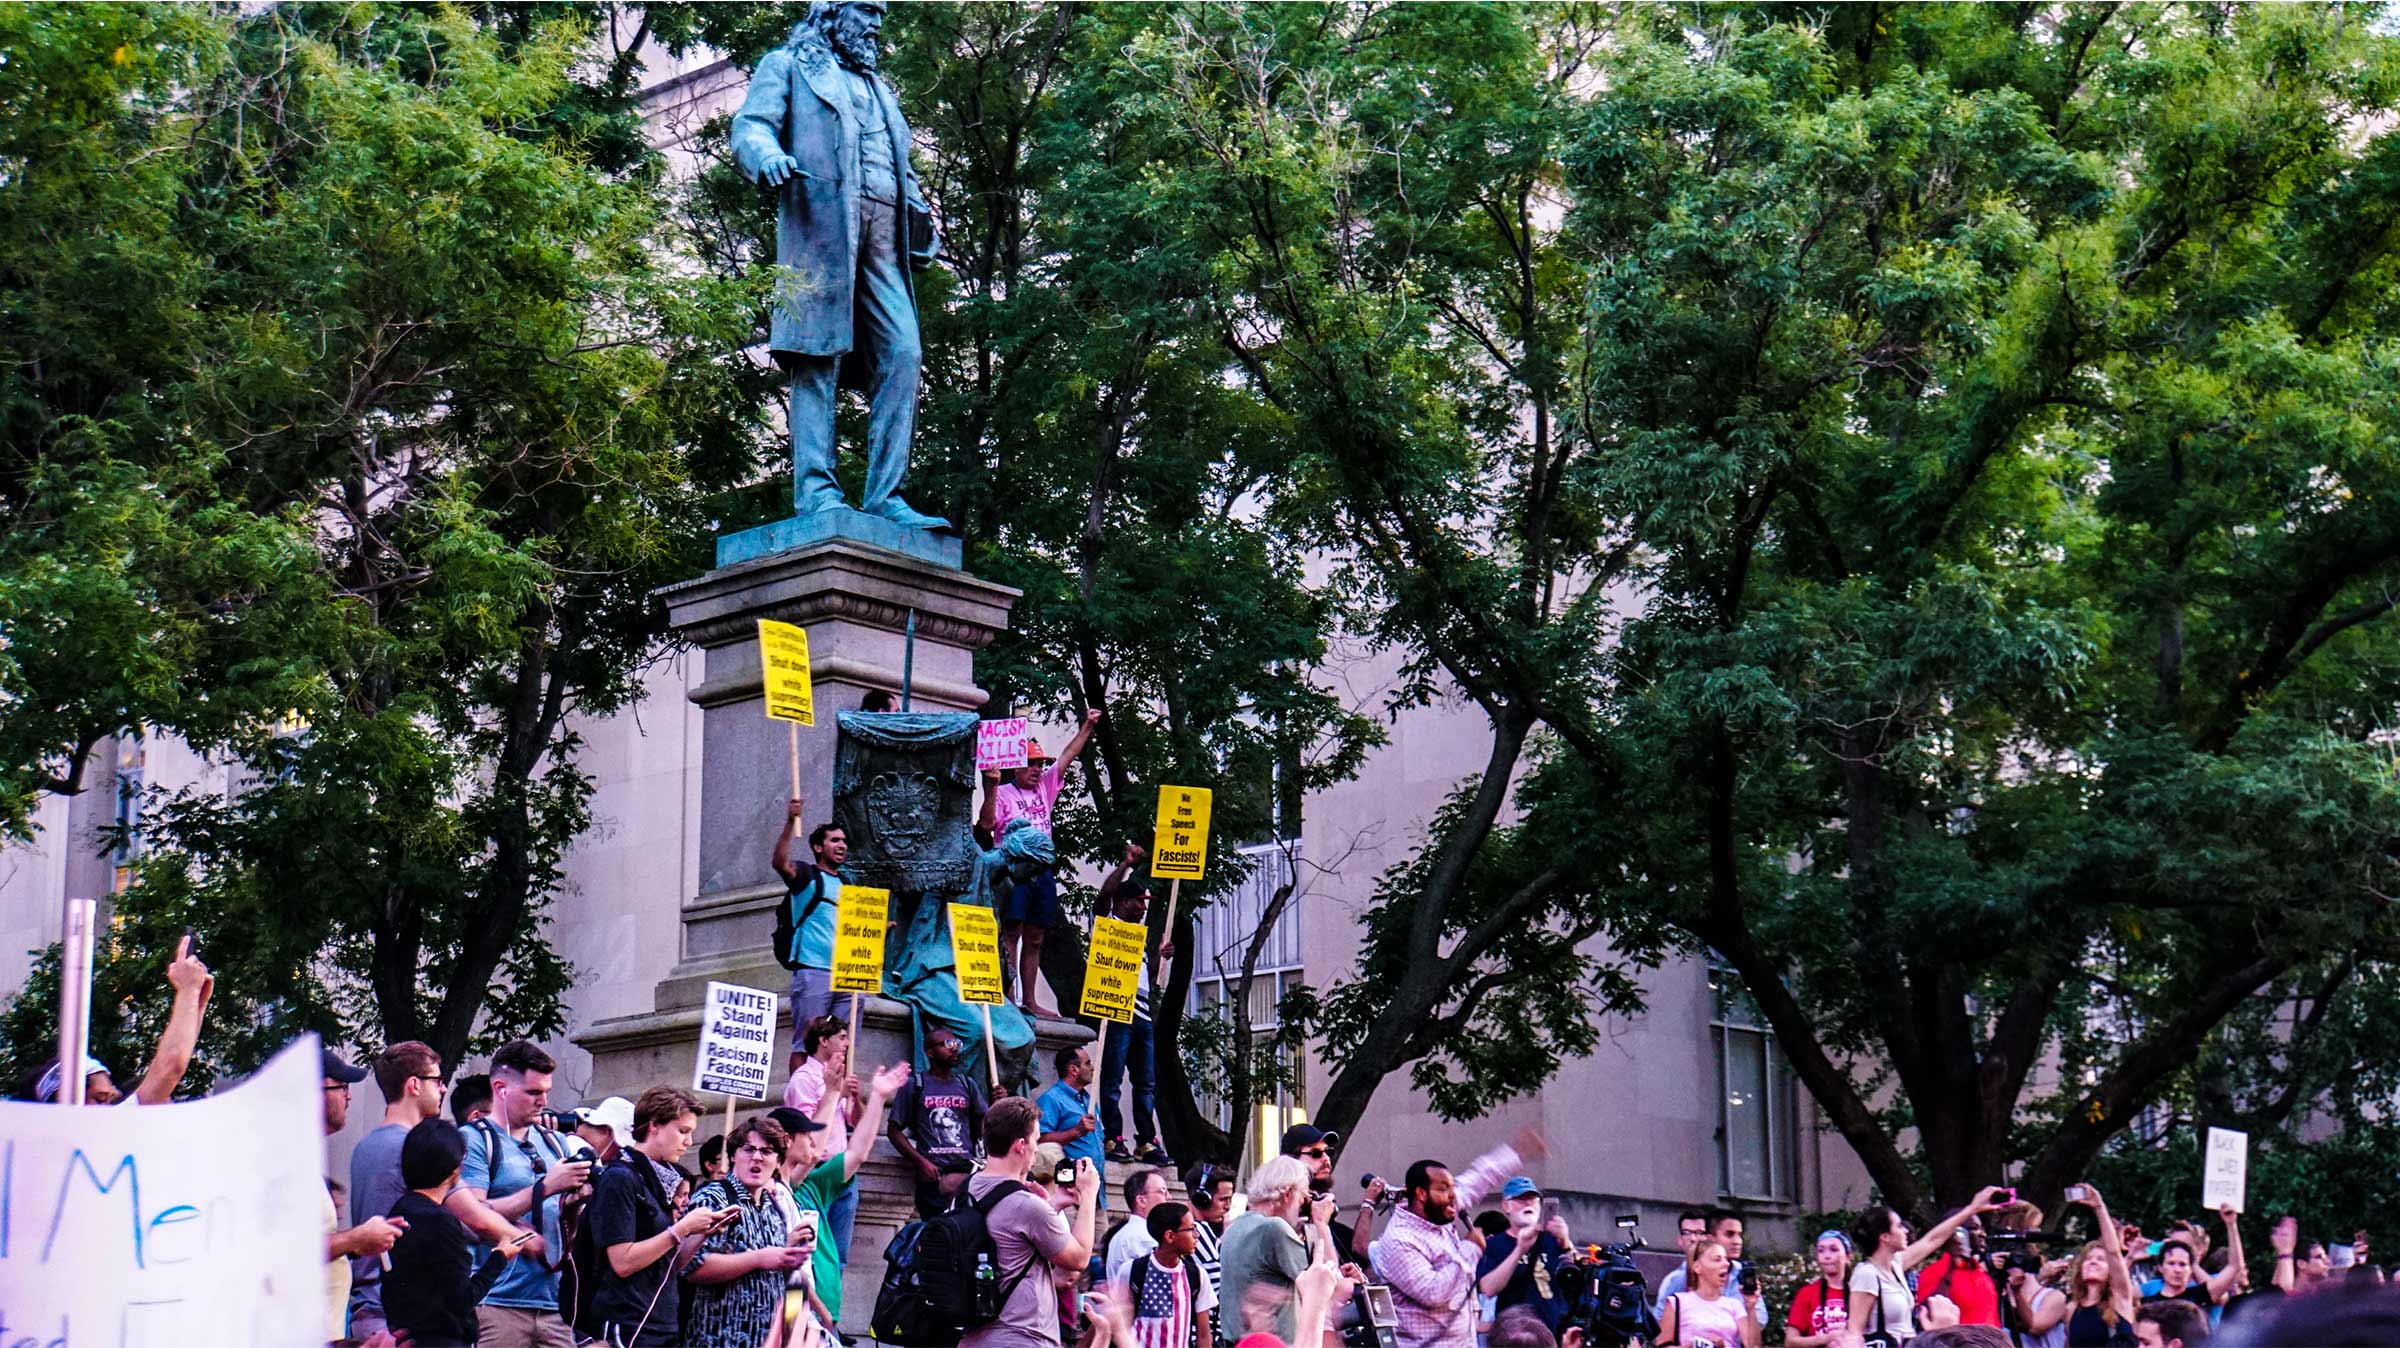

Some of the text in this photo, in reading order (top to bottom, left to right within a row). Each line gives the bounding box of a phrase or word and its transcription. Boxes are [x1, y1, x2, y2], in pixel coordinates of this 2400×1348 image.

[1181, 793, 1191, 803] No
[1177, 806, 1192, 816] Free
[1171, 819, 1195, 830] Speech
[1174, 833, 1190, 846] For
[1159, 849, 1200, 864] Fascists!
[843, 923, 882, 938] Shut down
[851, 946, 872, 959] white
[959, 938, 995, 954] Shut down
[969, 960, 990, 972] white
[1095, 951, 1137, 972] Shut down
[1100, 974, 1122, 989] white
[716, 988, 772, 1011] UNITE!
[1087, 988, 1134, 1008] supremacy!
[722, 1006, 763, 1026] Stand
[712, 1021, 769, 1043] Against
[707, 1042, 769, 1066] Racism &
[707, 1058, 765, 1081] Fascism
